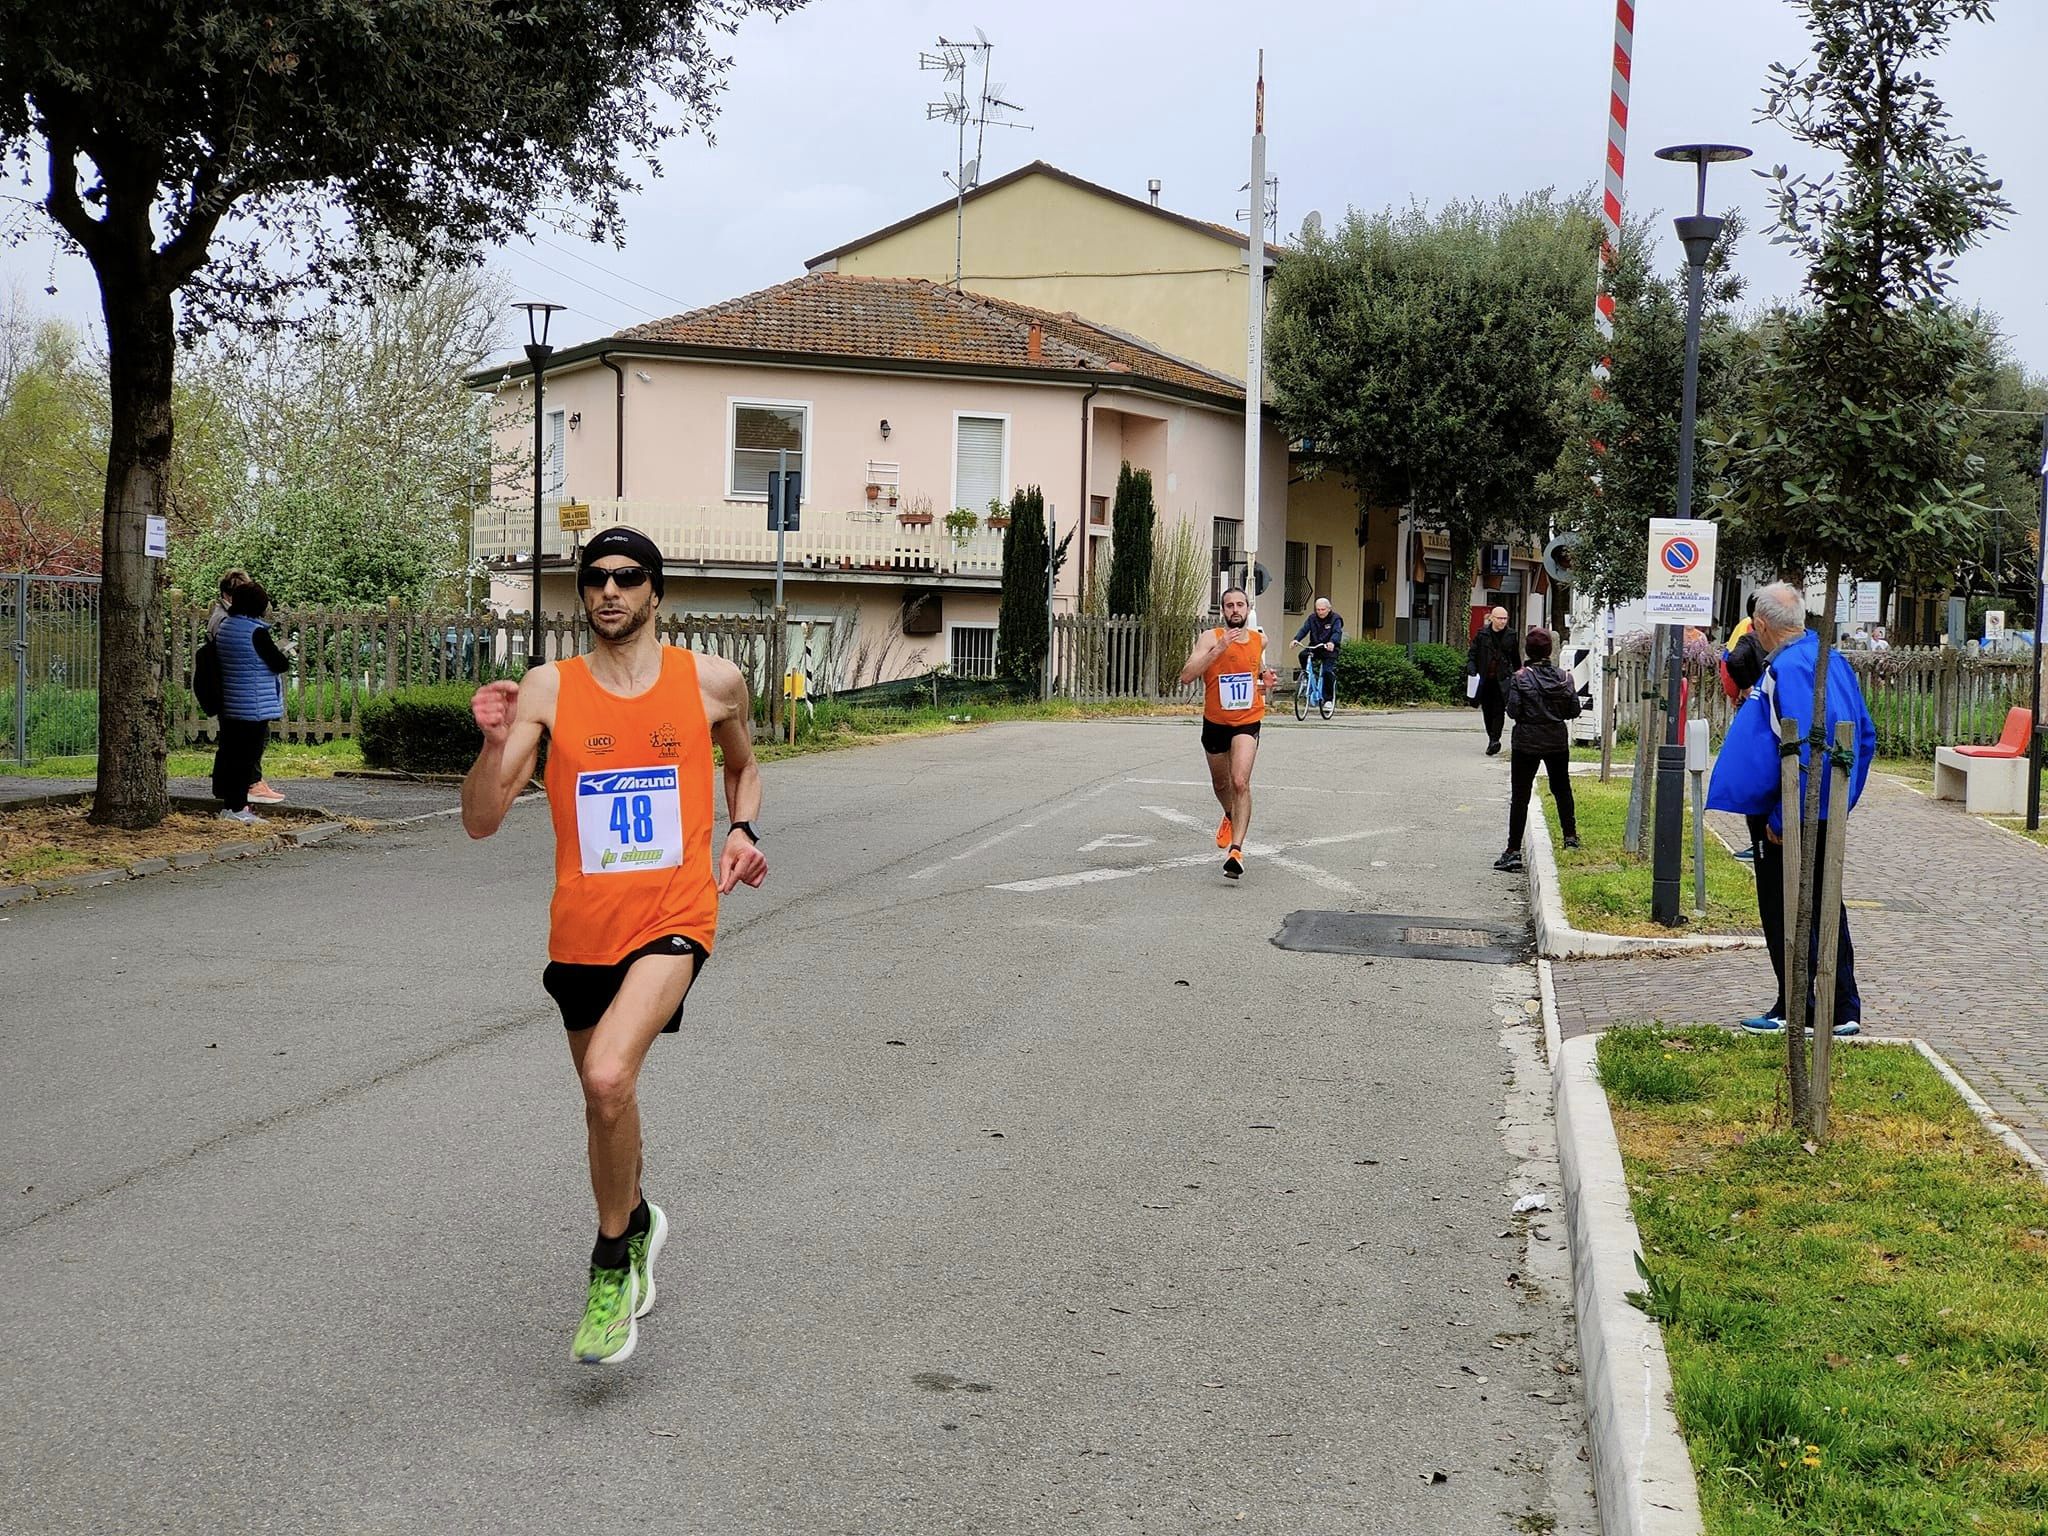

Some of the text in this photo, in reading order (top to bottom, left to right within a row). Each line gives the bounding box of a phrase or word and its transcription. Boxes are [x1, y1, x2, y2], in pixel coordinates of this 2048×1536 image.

[1428, 536, 1450, 547] TABACC
[1230, 682, 1248, 700] 117
[588, 737, 612, 746] LUCCI
[610, 795, 653, 844] 48
